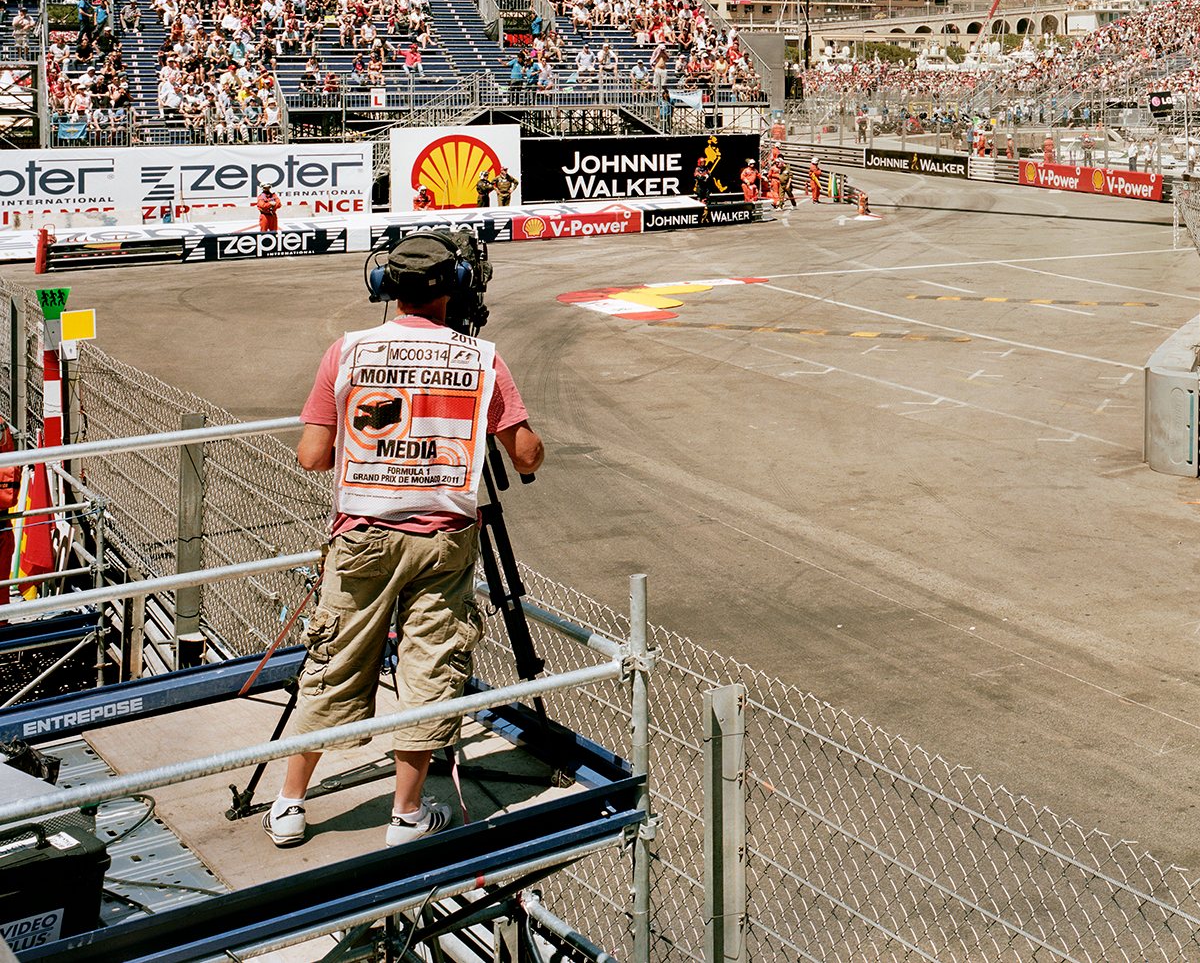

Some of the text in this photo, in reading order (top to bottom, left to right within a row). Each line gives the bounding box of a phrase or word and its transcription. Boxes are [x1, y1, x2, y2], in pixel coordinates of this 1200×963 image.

[374, 95, 383, 106] L
[562, 151, 682, 174] JOHNNIE
[867, 155, 965, 175] JOHNNIE WALKER
[180, 155, 363, 198] zepter
[1038, 169, 1079, 189] V-Power
[275, 189, 363, 197] TERNATIONAL
[565, 175, 681, 198] WALKER
[1106, 176, 1154, 198] V-Power
[2, 197, 114, 206] INTERNATIONAL
[550, 220, 628, 237] V-Power
[646, 210, 750, 228] JOHNNIE WALKER
[218, 228, 314, 260] zepter
[266, 249, 315, 257] INTERNATIONAL
[451, 332, 478, 347] 2011
[360, 368, 472, 387] MONTE CARLO
[376, 439, 437, 459] MEDIA
[353, 473, 379, 481] GRAND
[381, 474, 396, 483] PRIX
[398, 475, 409, 484] DE
[441, 475, 459, 484] 2011
[387, 467, 430, 476] FORMULA 1
[23, 697, 143, 736] ENTREPOSE
[0, 913, 58, 938] VIDEO
[9, 932, 47, 951] LUS
